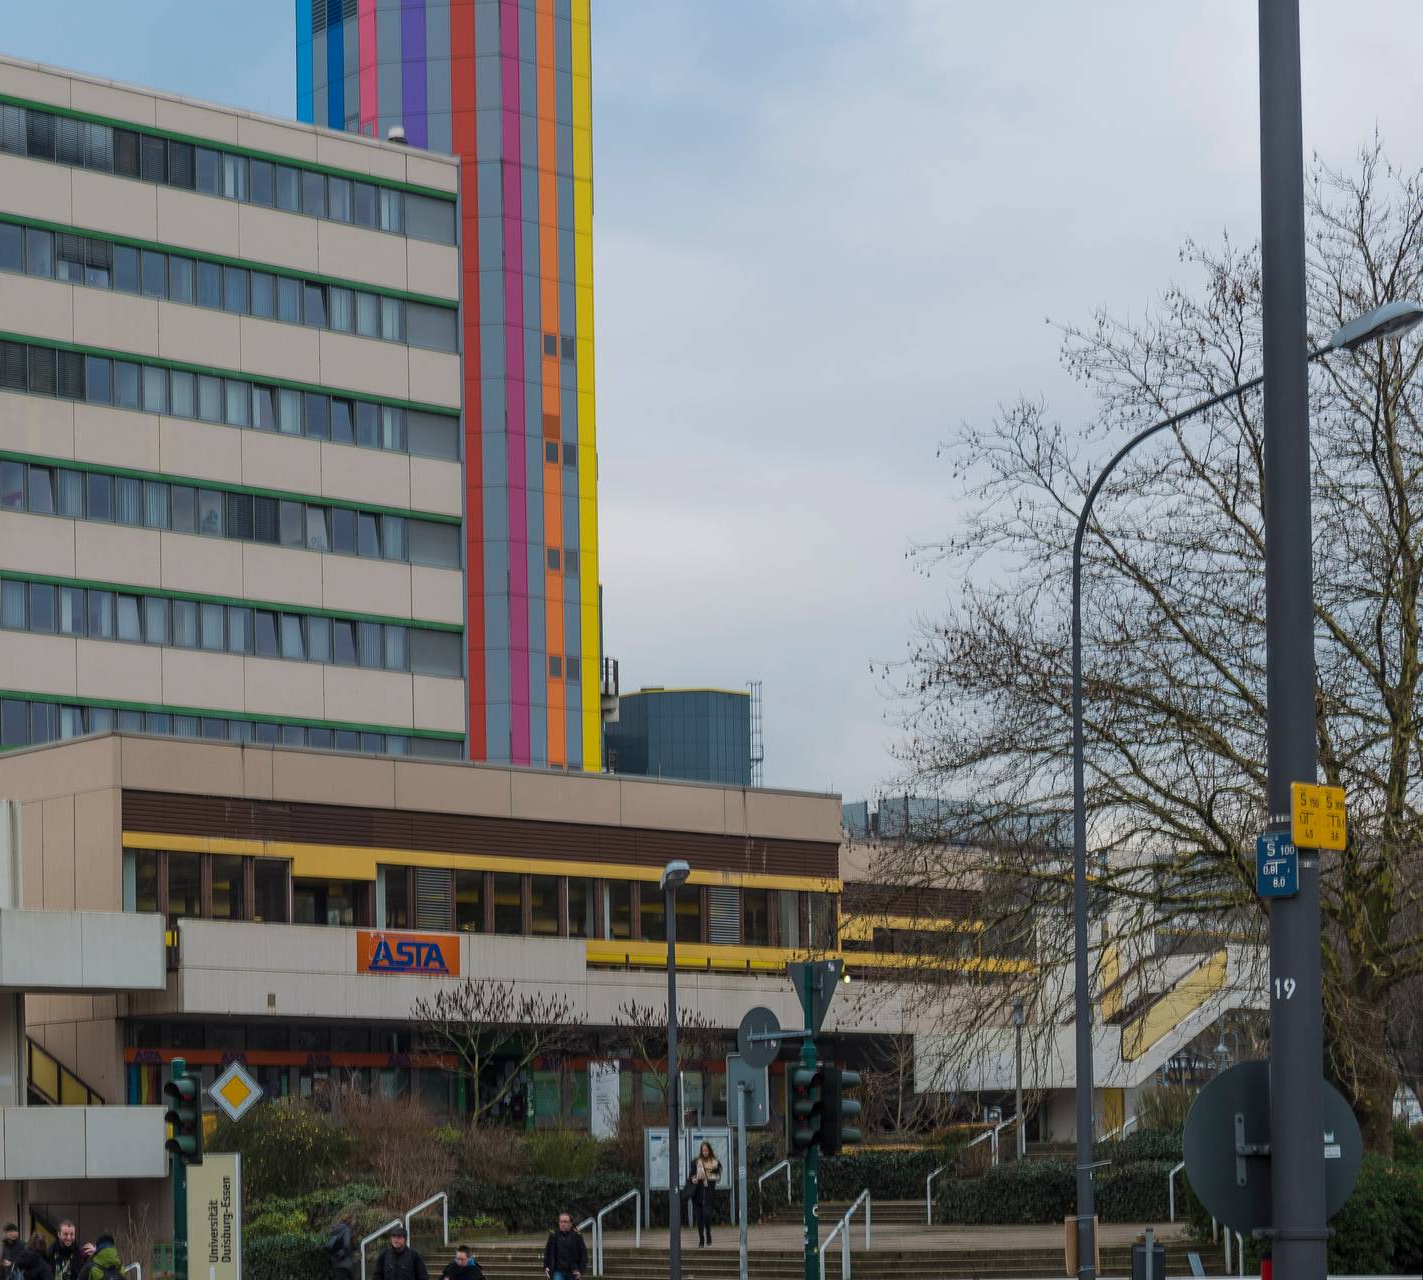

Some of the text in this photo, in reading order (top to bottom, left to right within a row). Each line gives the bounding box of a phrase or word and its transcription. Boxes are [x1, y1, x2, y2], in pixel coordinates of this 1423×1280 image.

[1266, 843, 1295, 857] S 100
[371, 940, 447, 969] ASTA
[1274, 977, 1296, 1000] 19
[209, 1199, 219, 1263] Universität
[221, 1176, 233, 1263] Duisburg-Essen
